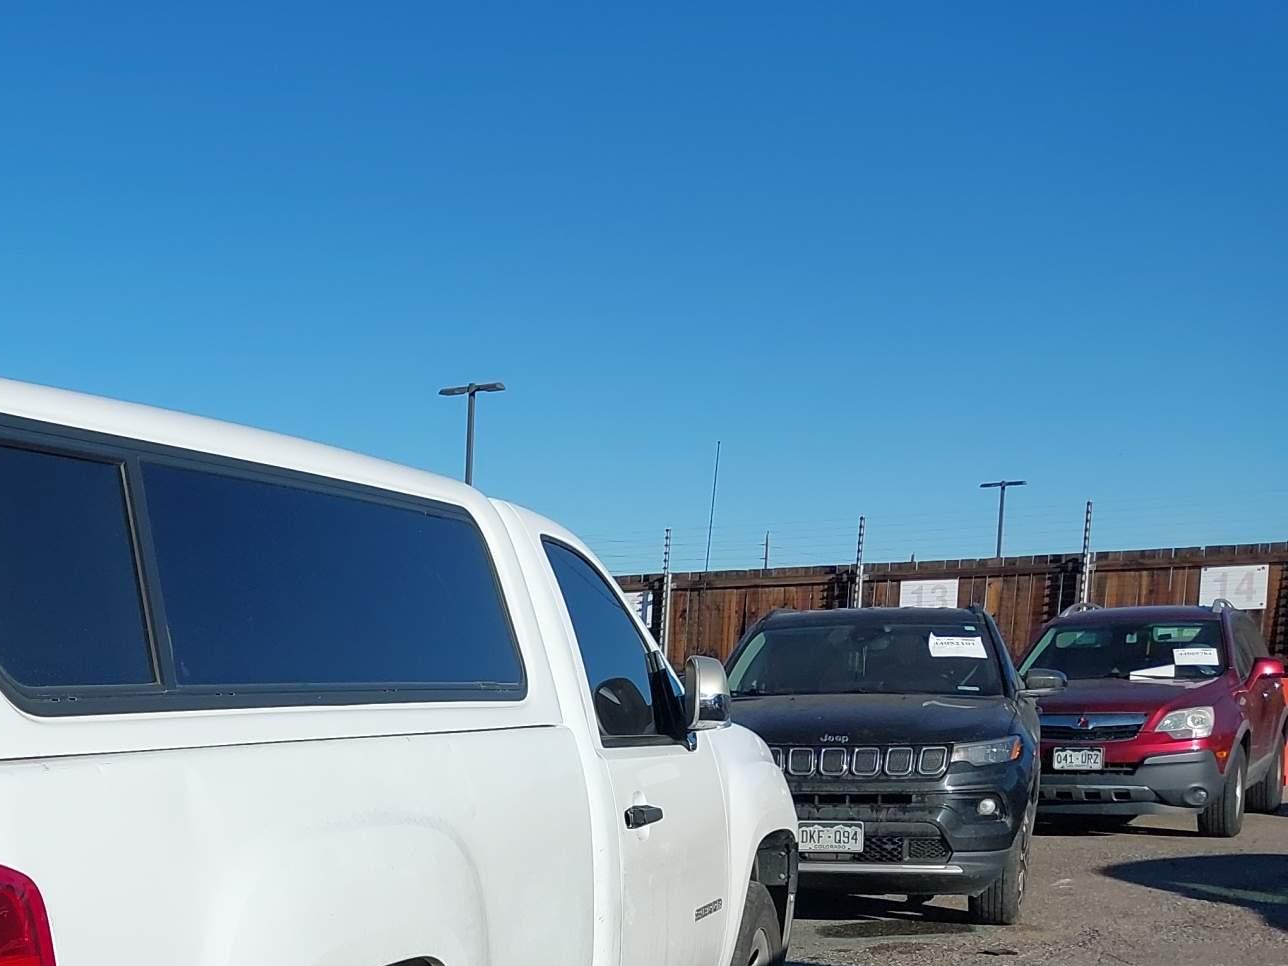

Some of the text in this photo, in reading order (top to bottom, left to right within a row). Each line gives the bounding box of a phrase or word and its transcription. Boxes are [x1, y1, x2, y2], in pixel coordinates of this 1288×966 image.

[912, 582, 947, 606] 13
[1214, 572, 1256, 600] 14
[820, 734, 849, 744] Jeep
